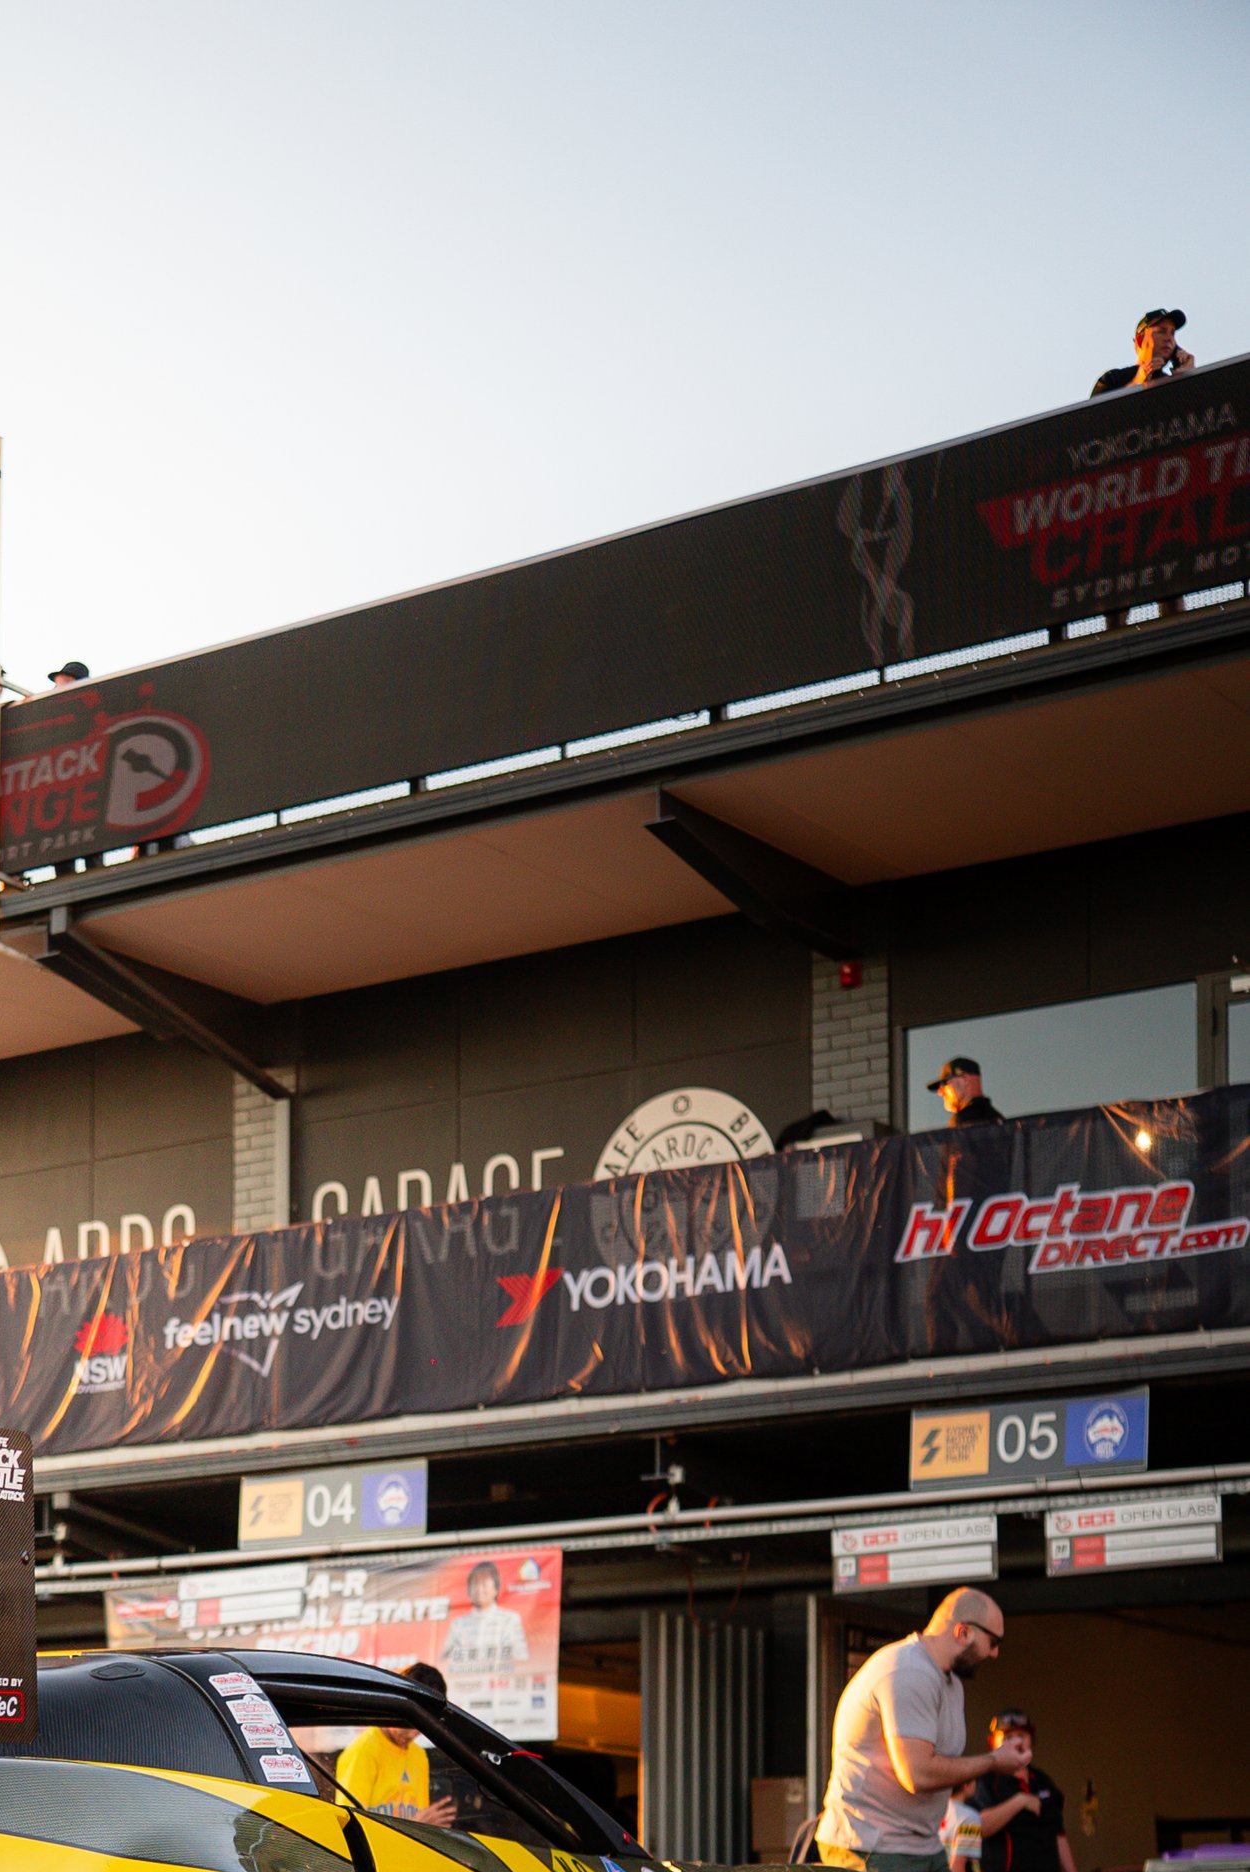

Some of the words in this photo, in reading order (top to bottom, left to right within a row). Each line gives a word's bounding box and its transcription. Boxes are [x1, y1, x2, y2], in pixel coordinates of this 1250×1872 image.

[1068, 402, 1238, 471] YOKOHAMA
[1014, 456, 1191, 536] WORLD
[1052, 560, 1179, 608] SYDNEY
[651, 1130, 714, 1171] ARDC
[967, 1180, 1195, 1252] Octane
[562, 1241, 793, 1311] YOKOHAMA
[292, 1295, 400, 1341] sydney
[996, 1410, 1058, 1464] 05
[307, 1481, 355, 1527] 04
[1121, 1508, 1162, 1524] OPEN
[1167, 1503, 1216, 1519] CLASS
[903, 1528, 943, 1543] OPEN
[946, 1523, 992, 1538] CLASS
[340, 1595, 451, 1628] ESTATE
[9, 1677, 23, 1688] BY
